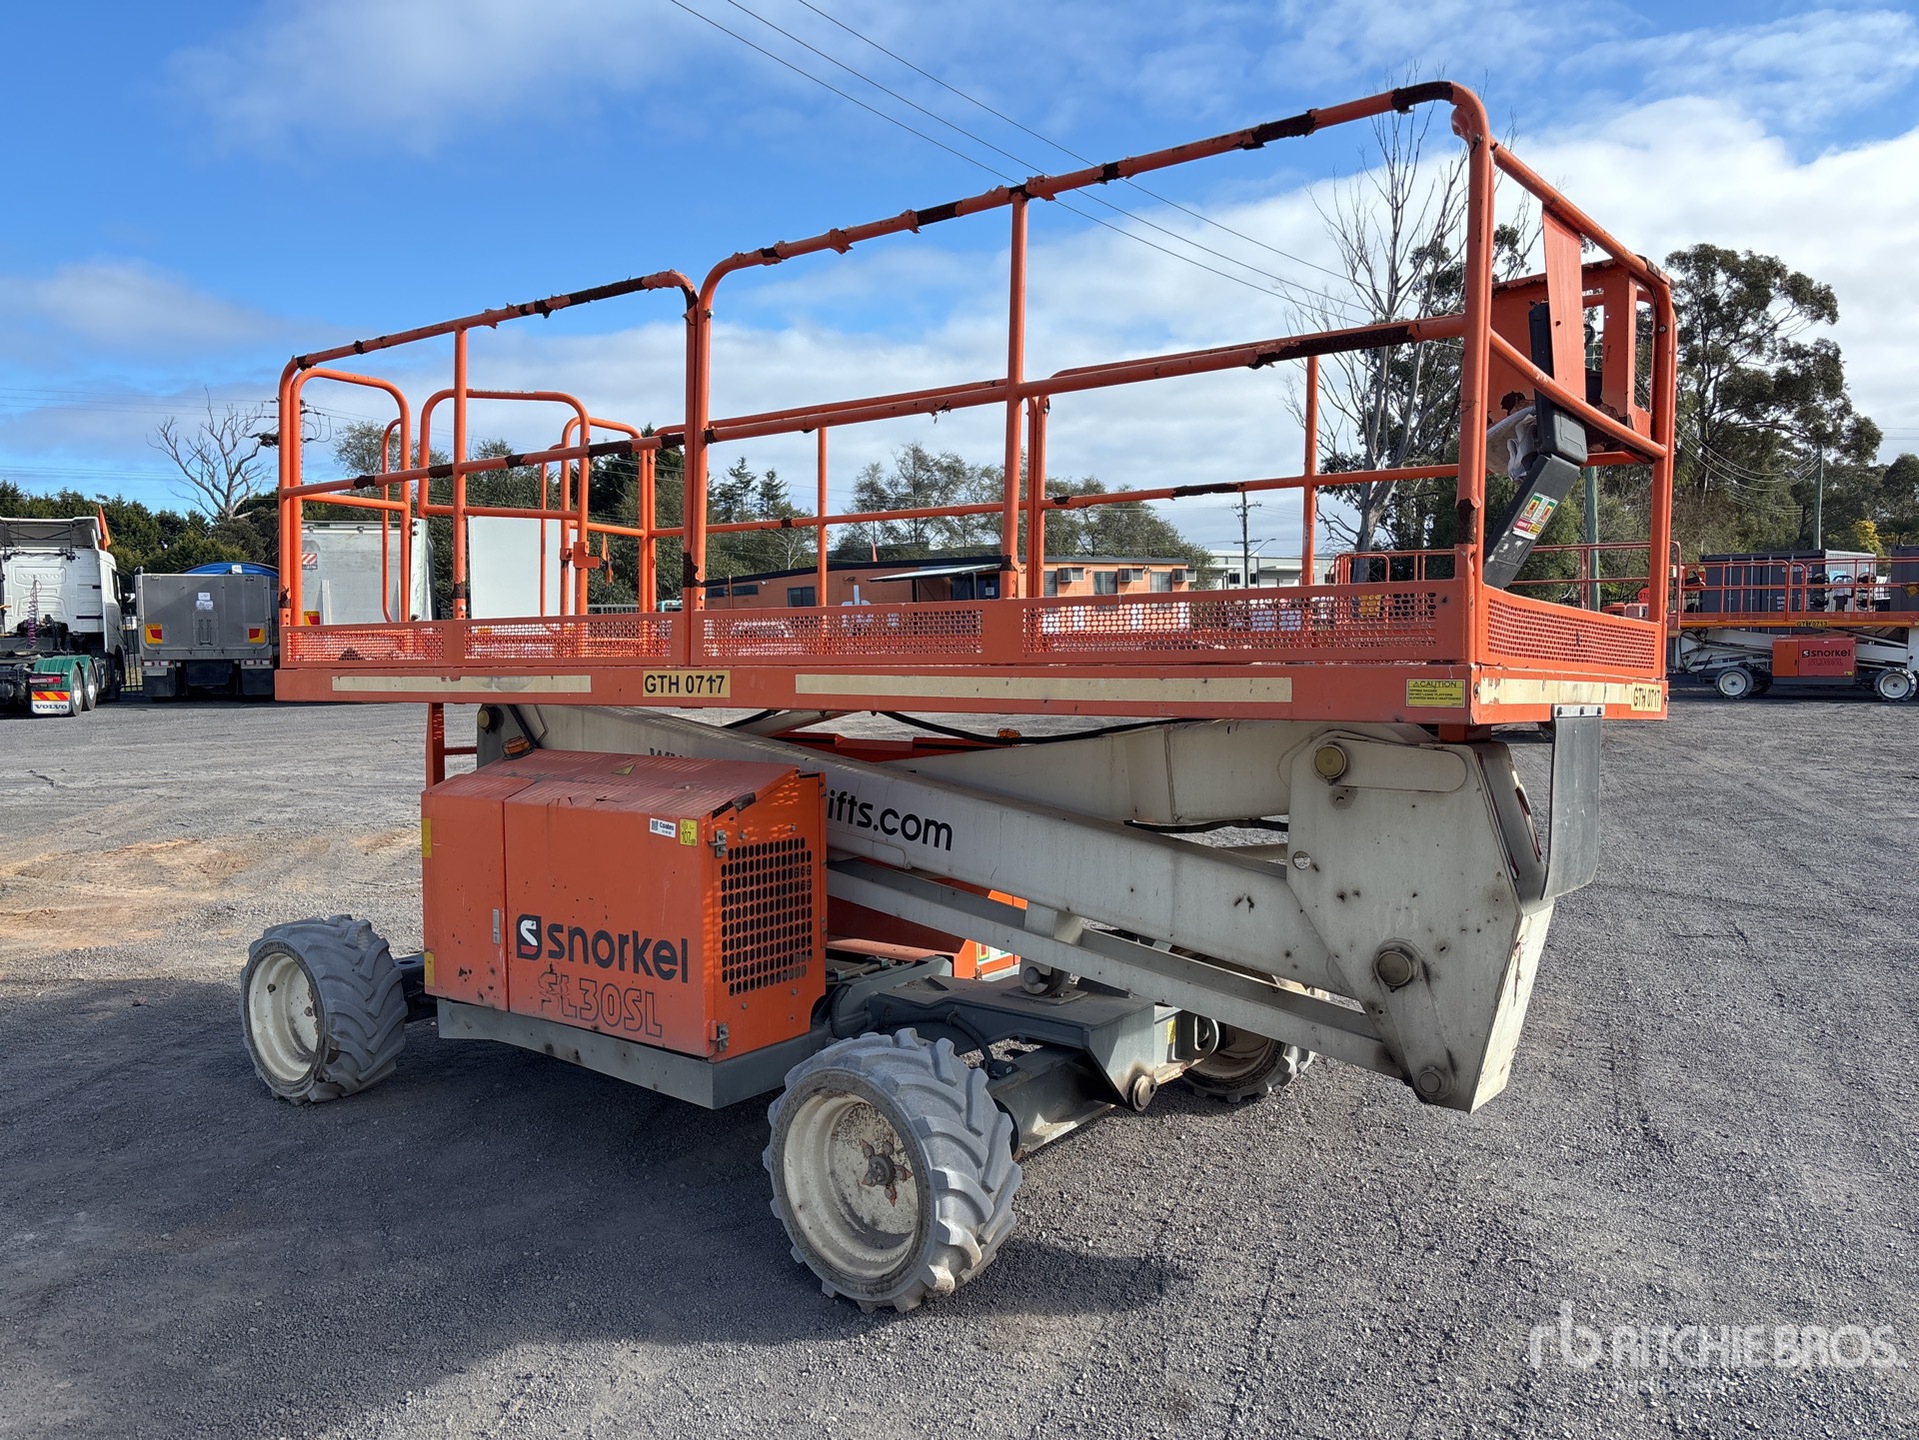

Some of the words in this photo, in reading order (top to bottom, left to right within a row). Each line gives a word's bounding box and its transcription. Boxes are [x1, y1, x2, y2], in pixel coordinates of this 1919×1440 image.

[1810, 650, 1851, 658] snorkel
[644, 674, 680, 694] GTH
[685, 674, 726, 694] 0717
[1633, 687, 1647, 707] GTH
[1647, 688, 1661, 708] 0717
[827, 789, 952, 851] ifts.com
[547, 923, 688, 983] snorkel
